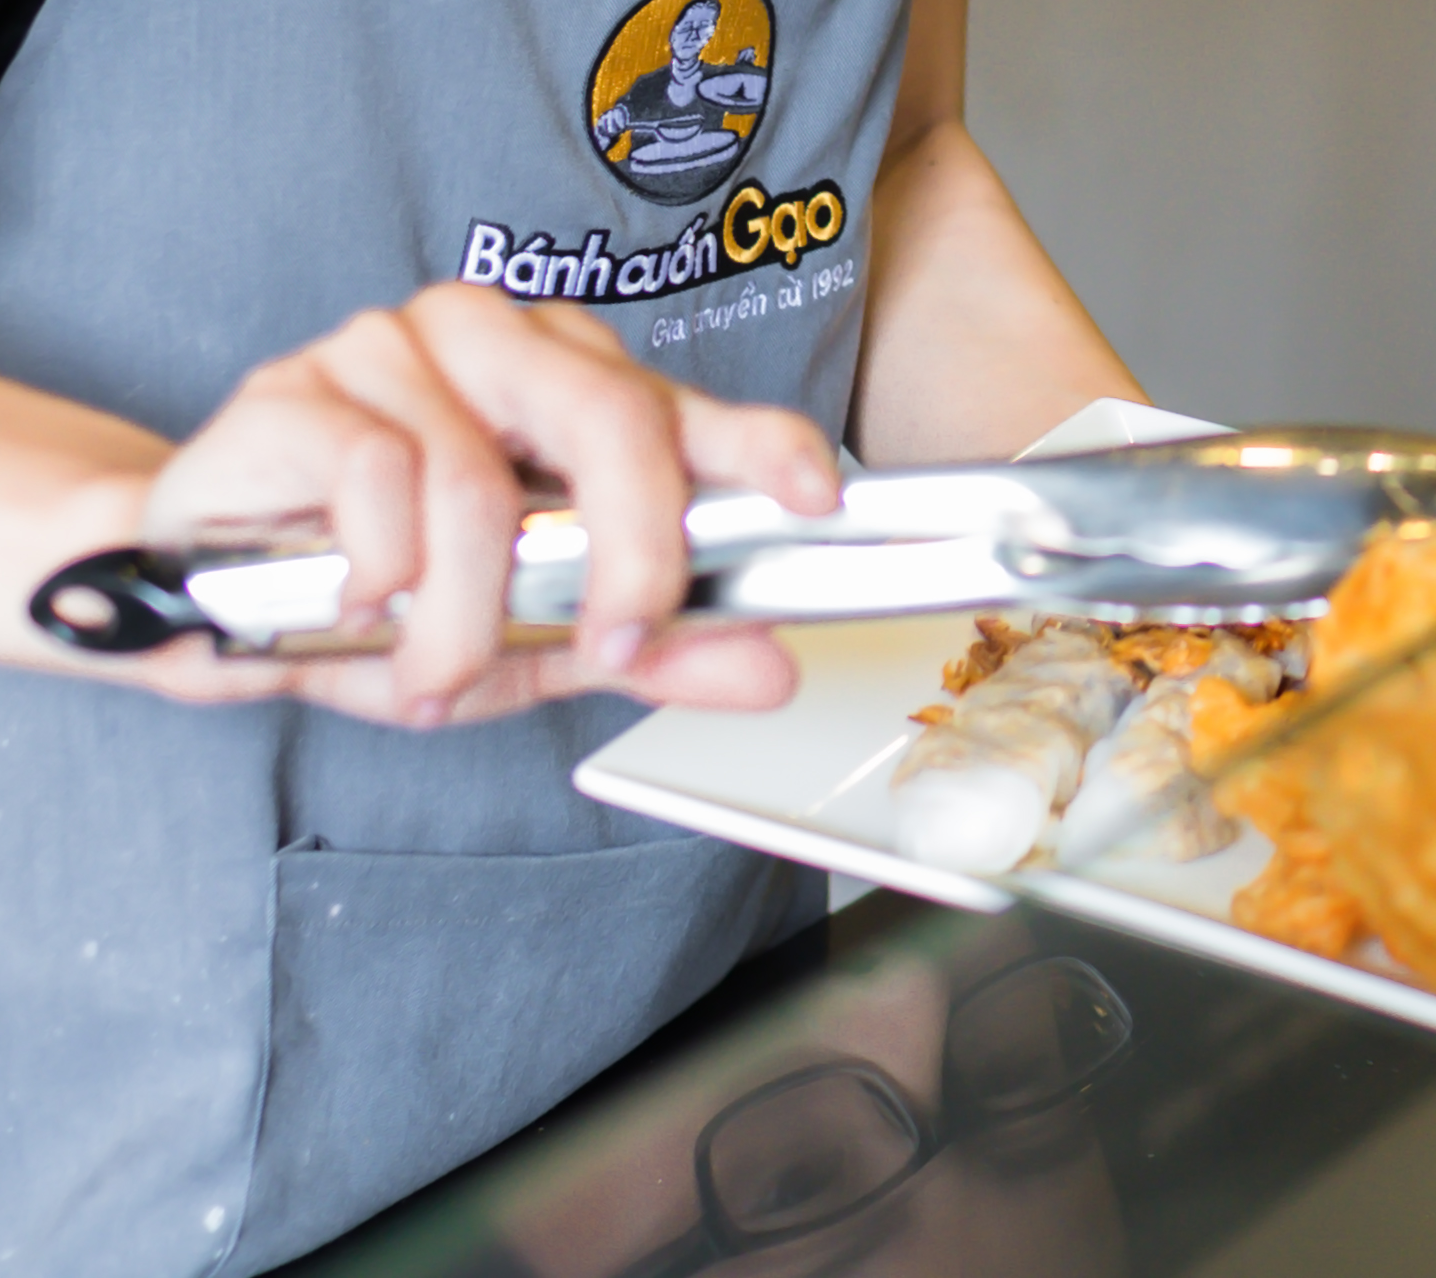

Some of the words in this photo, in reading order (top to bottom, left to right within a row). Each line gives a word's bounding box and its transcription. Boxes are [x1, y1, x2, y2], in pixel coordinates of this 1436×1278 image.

[462, 222, 612, 296] Bánh
[615, 217, 718, 295] cuốn
[722, 186, 843, 265] Gạo
[651, 317, 686, 348] Gia
[811, 259, 855, 301] 1992
